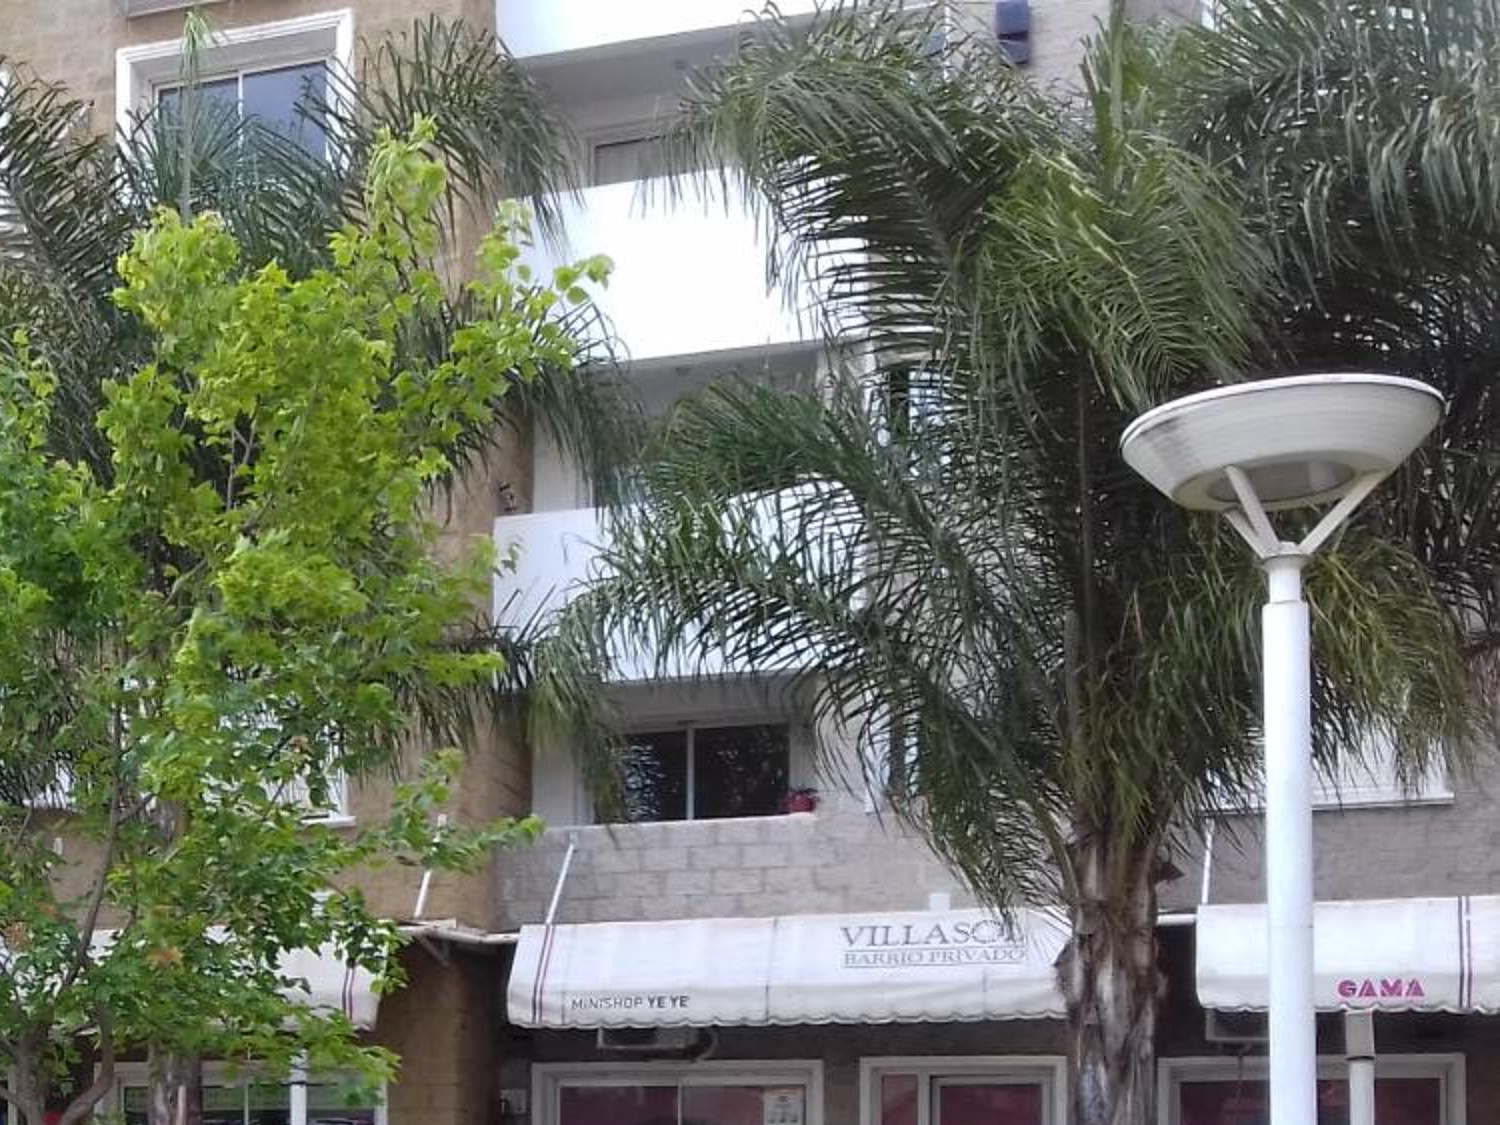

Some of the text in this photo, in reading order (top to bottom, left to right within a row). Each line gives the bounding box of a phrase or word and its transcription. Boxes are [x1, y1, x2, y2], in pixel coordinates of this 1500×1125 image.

[844, 948, 1026, 966] BARRIO PRIVADO
[1338, 979, 1425, 998] GAMA
